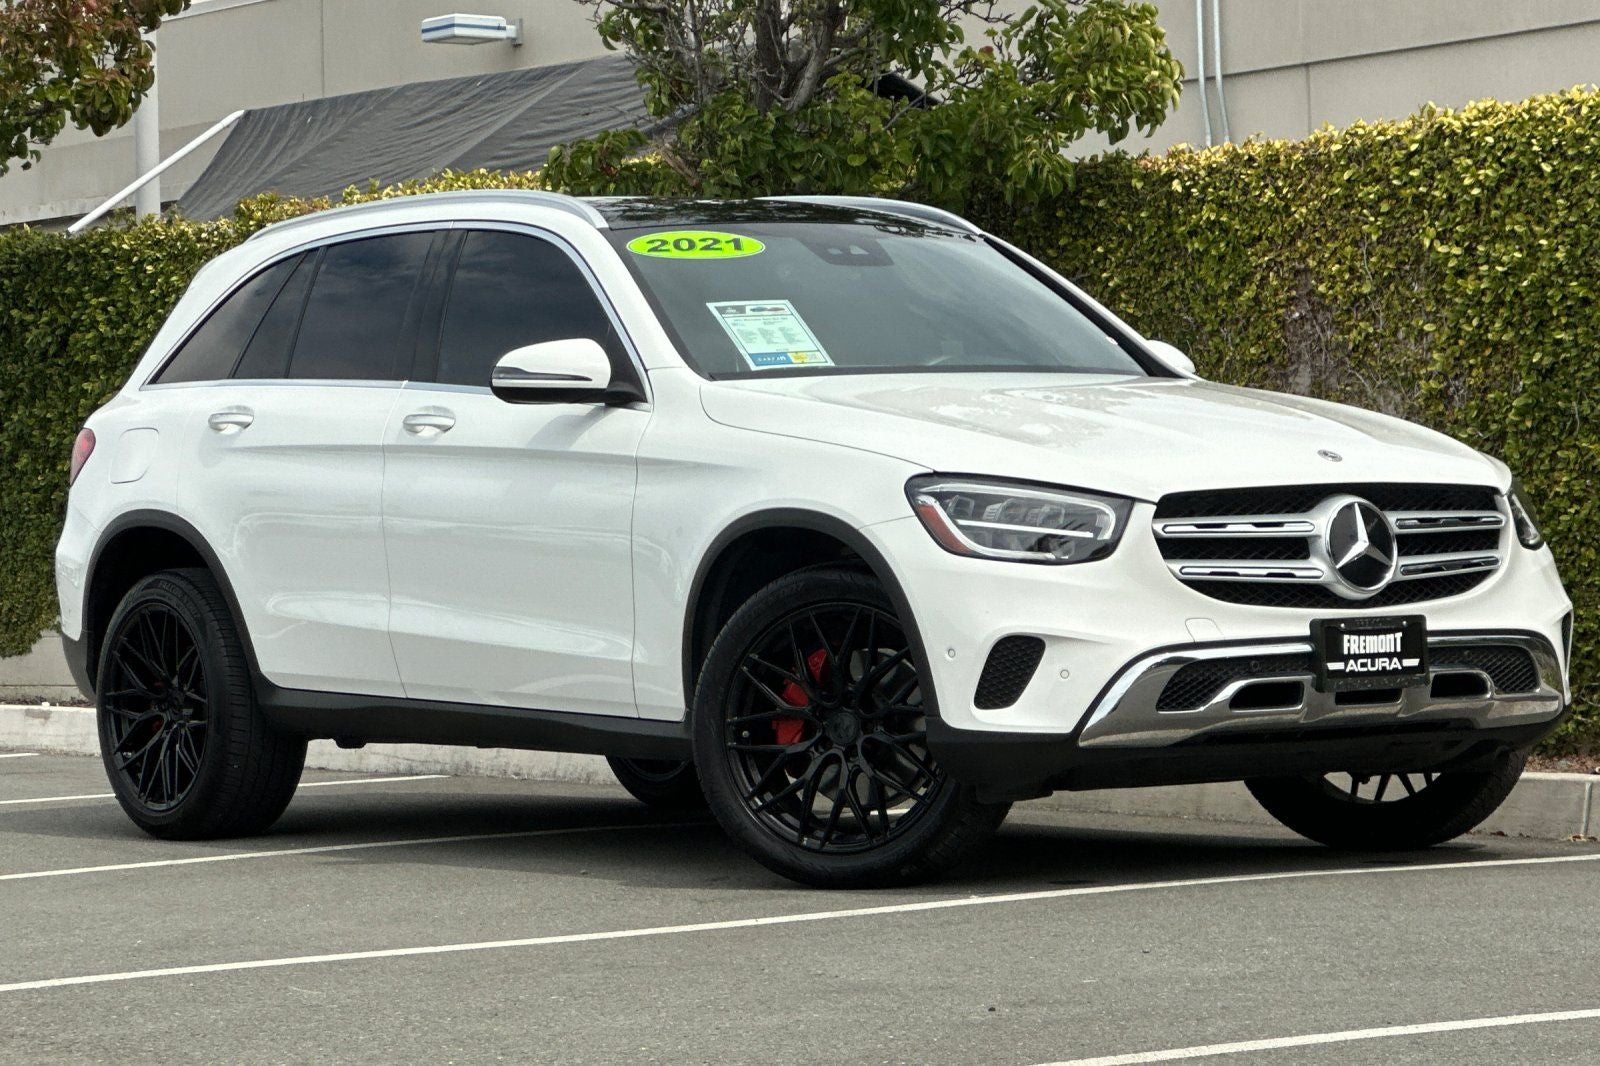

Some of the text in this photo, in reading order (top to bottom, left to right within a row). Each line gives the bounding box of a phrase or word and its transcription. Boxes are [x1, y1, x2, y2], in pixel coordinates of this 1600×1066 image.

[646, 237, 743, 252] 2021
[1343, 631, 1403, 655] FREMONT
[1345, 657, 1402, 672] ACURA
